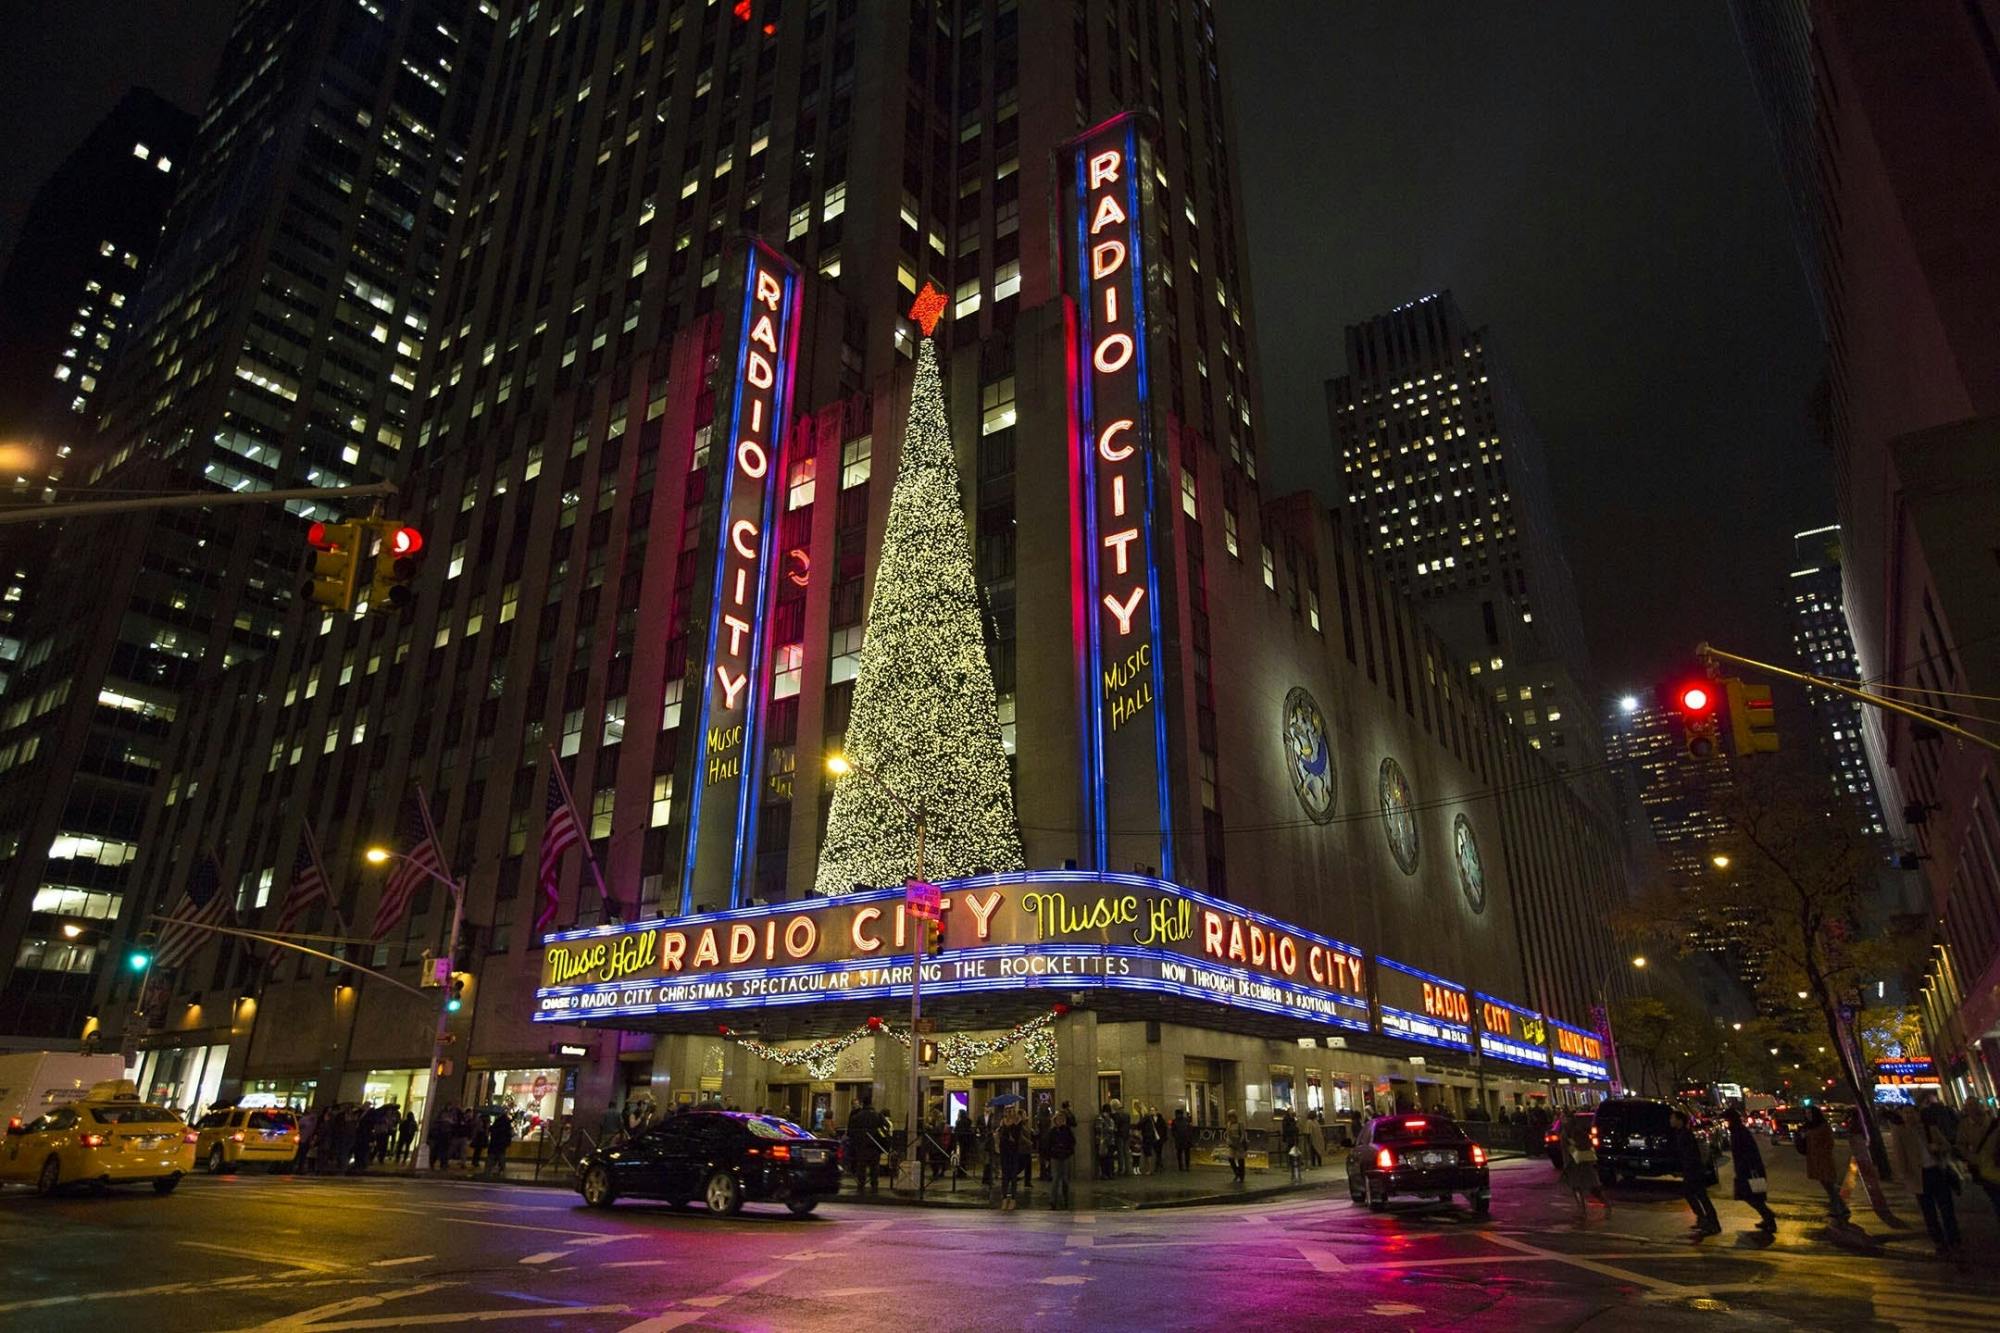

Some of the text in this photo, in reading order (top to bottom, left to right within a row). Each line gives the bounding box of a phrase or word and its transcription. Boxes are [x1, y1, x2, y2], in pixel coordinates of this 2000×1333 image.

[1090, 149, 1145, 635] RADIO CITY
[716, 269, 782, 710] RADIO CITY
[548, 943, 605, 985] Music
[600, 930, 657, 981] Hall
[662, 915, 817, 971] RADIO
[851, 891, 1003, 952] CIY
[1021, 892, 1138, 940] Music
[1133, 897, 1194, 945] Hall
[1203, 911, 1362, 993] RADIO CITY
[581, 991, 618, 1008] RADIO
[624, 987, 653, 1006] CITY
[659, 983, 733, 1003] CHRISTMAS
[742, 971, 850, 996] SPECTACULAR
[860, 964, 942, 987] STARRNG
[954, 958, 986, 979] THE
[1000, 956, 1129, 976] ROCKETTES
[1161, 962, 1186, 983] NOW
[1192, 970, 1235, 992] THROUGH
[1237, 980, 1282, 1004] DECEMBER
[1422, 982, 1470, 1023] RADIO
[1483, 1003, 1512, 1035] CITY
[1879, 1075, 1913, 1084] NBC
